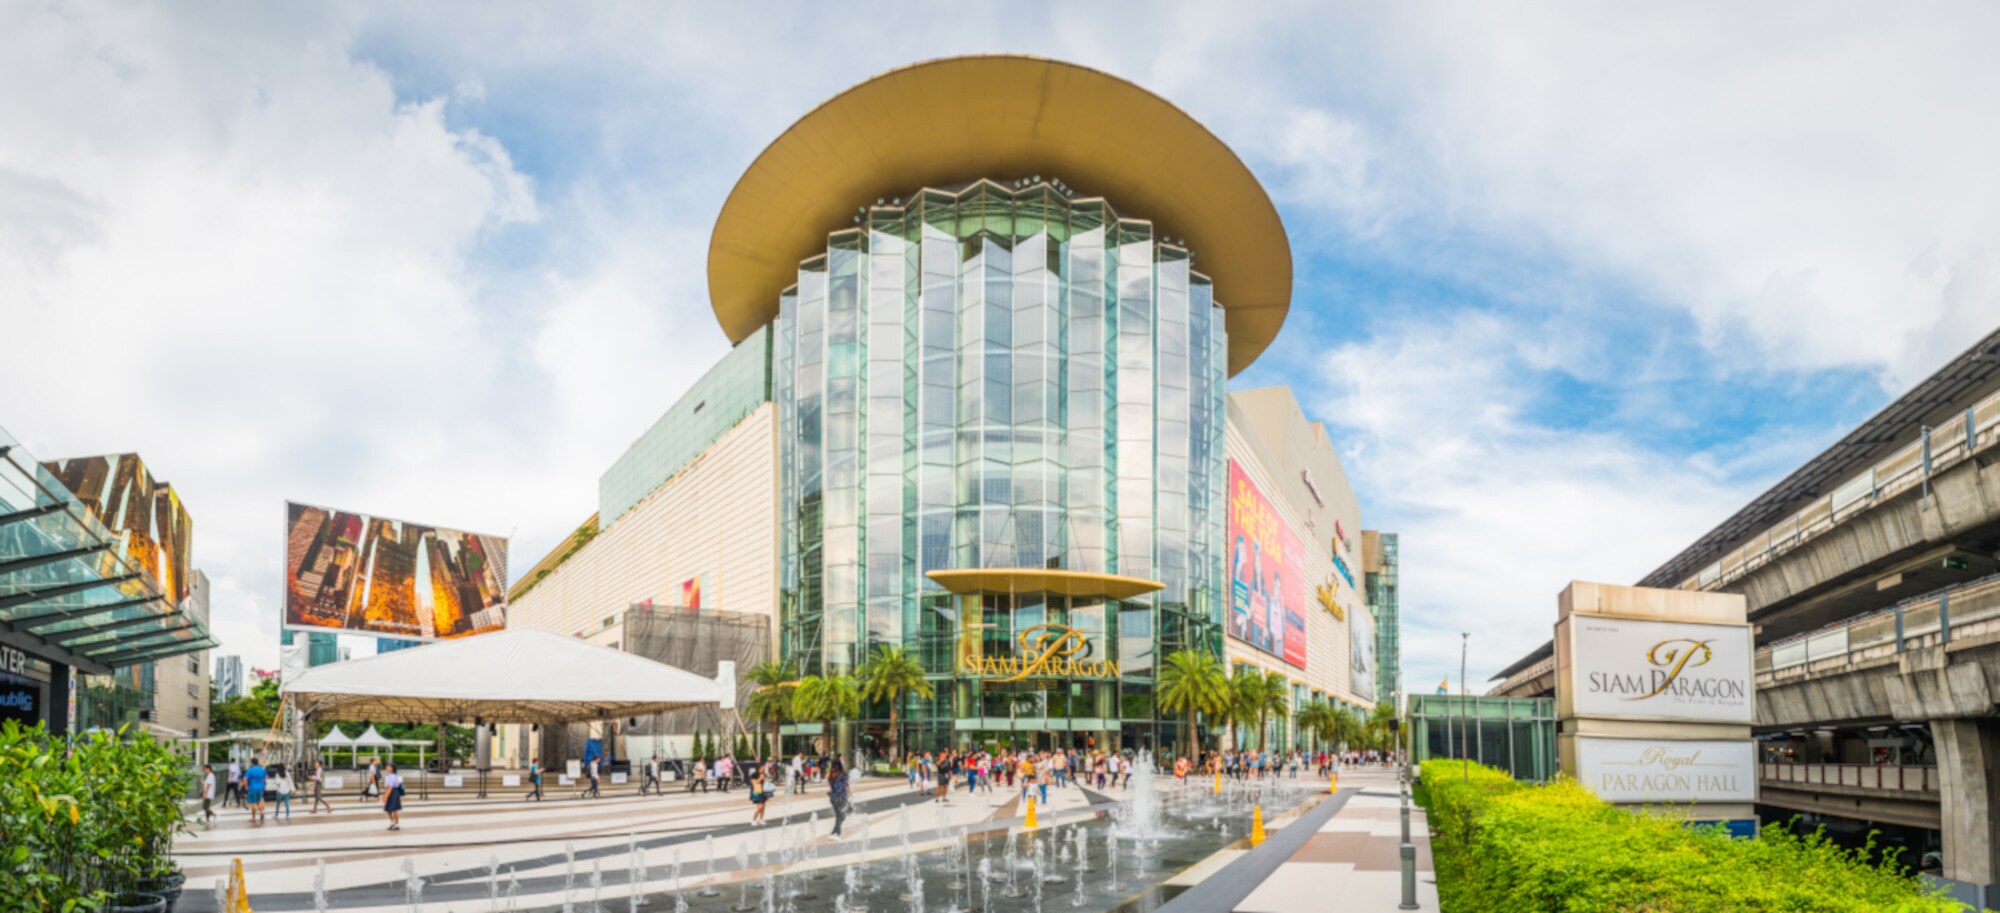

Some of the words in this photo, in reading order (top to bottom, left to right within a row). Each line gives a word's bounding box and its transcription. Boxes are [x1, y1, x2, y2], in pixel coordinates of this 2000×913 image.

[1237, 479, 1265, 526] SALE
[1265, 511, 1279, 540] OF
[1232, 498, 1255, 539] THE
[1256, 519, 1283, 565] YEAR
[965, 654, 1018, 675] SIAM
[1021, 649, 1120, 679] PARAGON
[1588, 671, 1645, 694] SIAM
[1650, 669, 1745, 699] PARAGON
[1638, 745, 1700, 771] Royal
[1601, 773, 1690, 792] PARAGON
[1697, 774, 1741, 792] HALL
